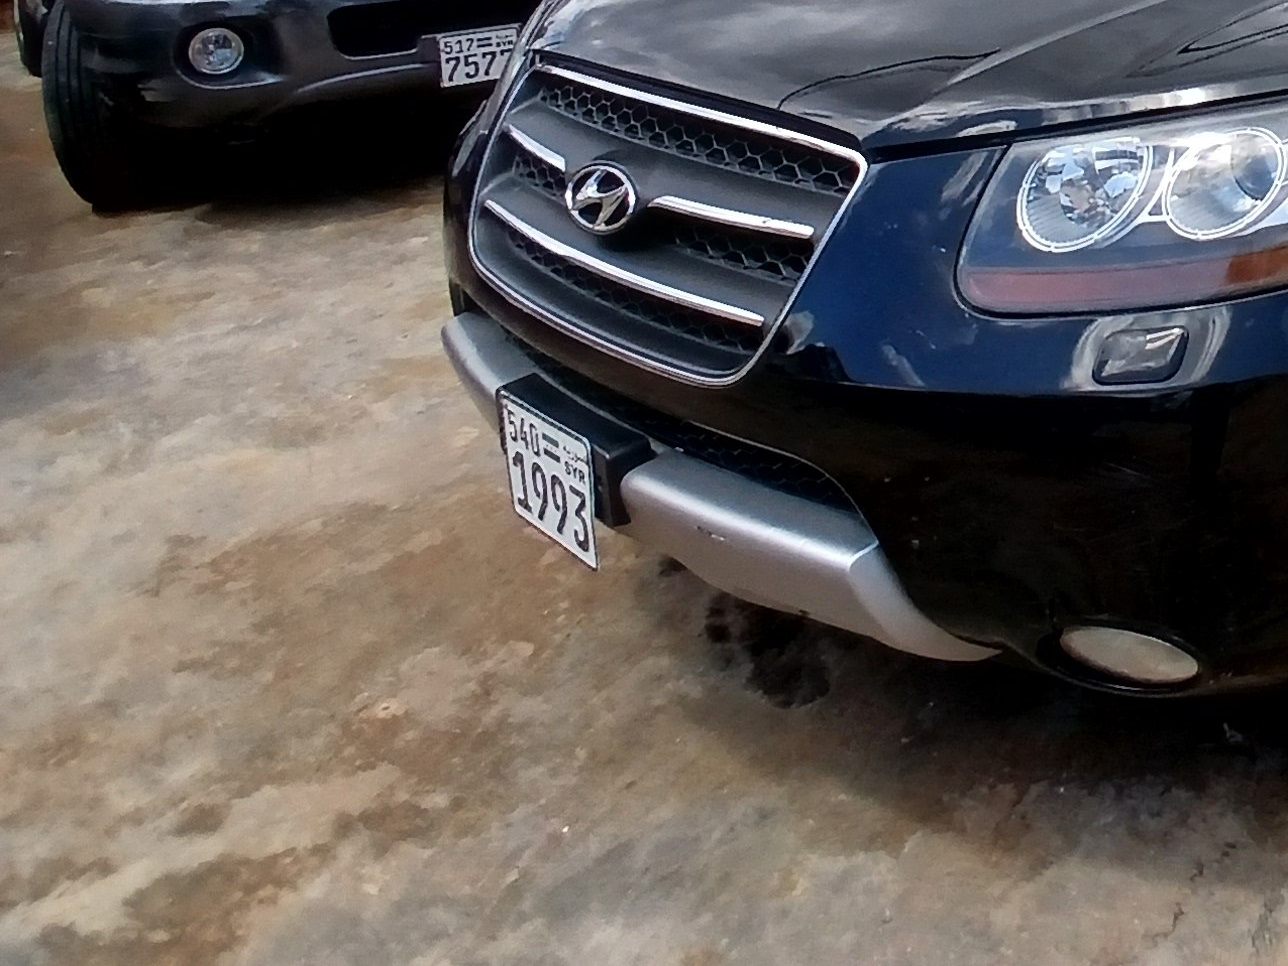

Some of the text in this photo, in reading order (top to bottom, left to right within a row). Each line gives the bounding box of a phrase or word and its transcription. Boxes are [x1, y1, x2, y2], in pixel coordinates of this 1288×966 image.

[444, 38, 474, 55] 517
[507, 410, 540, 457] 540
[564, 461, 586, 485] SYR
[513, 451, 590, 552] 1993
